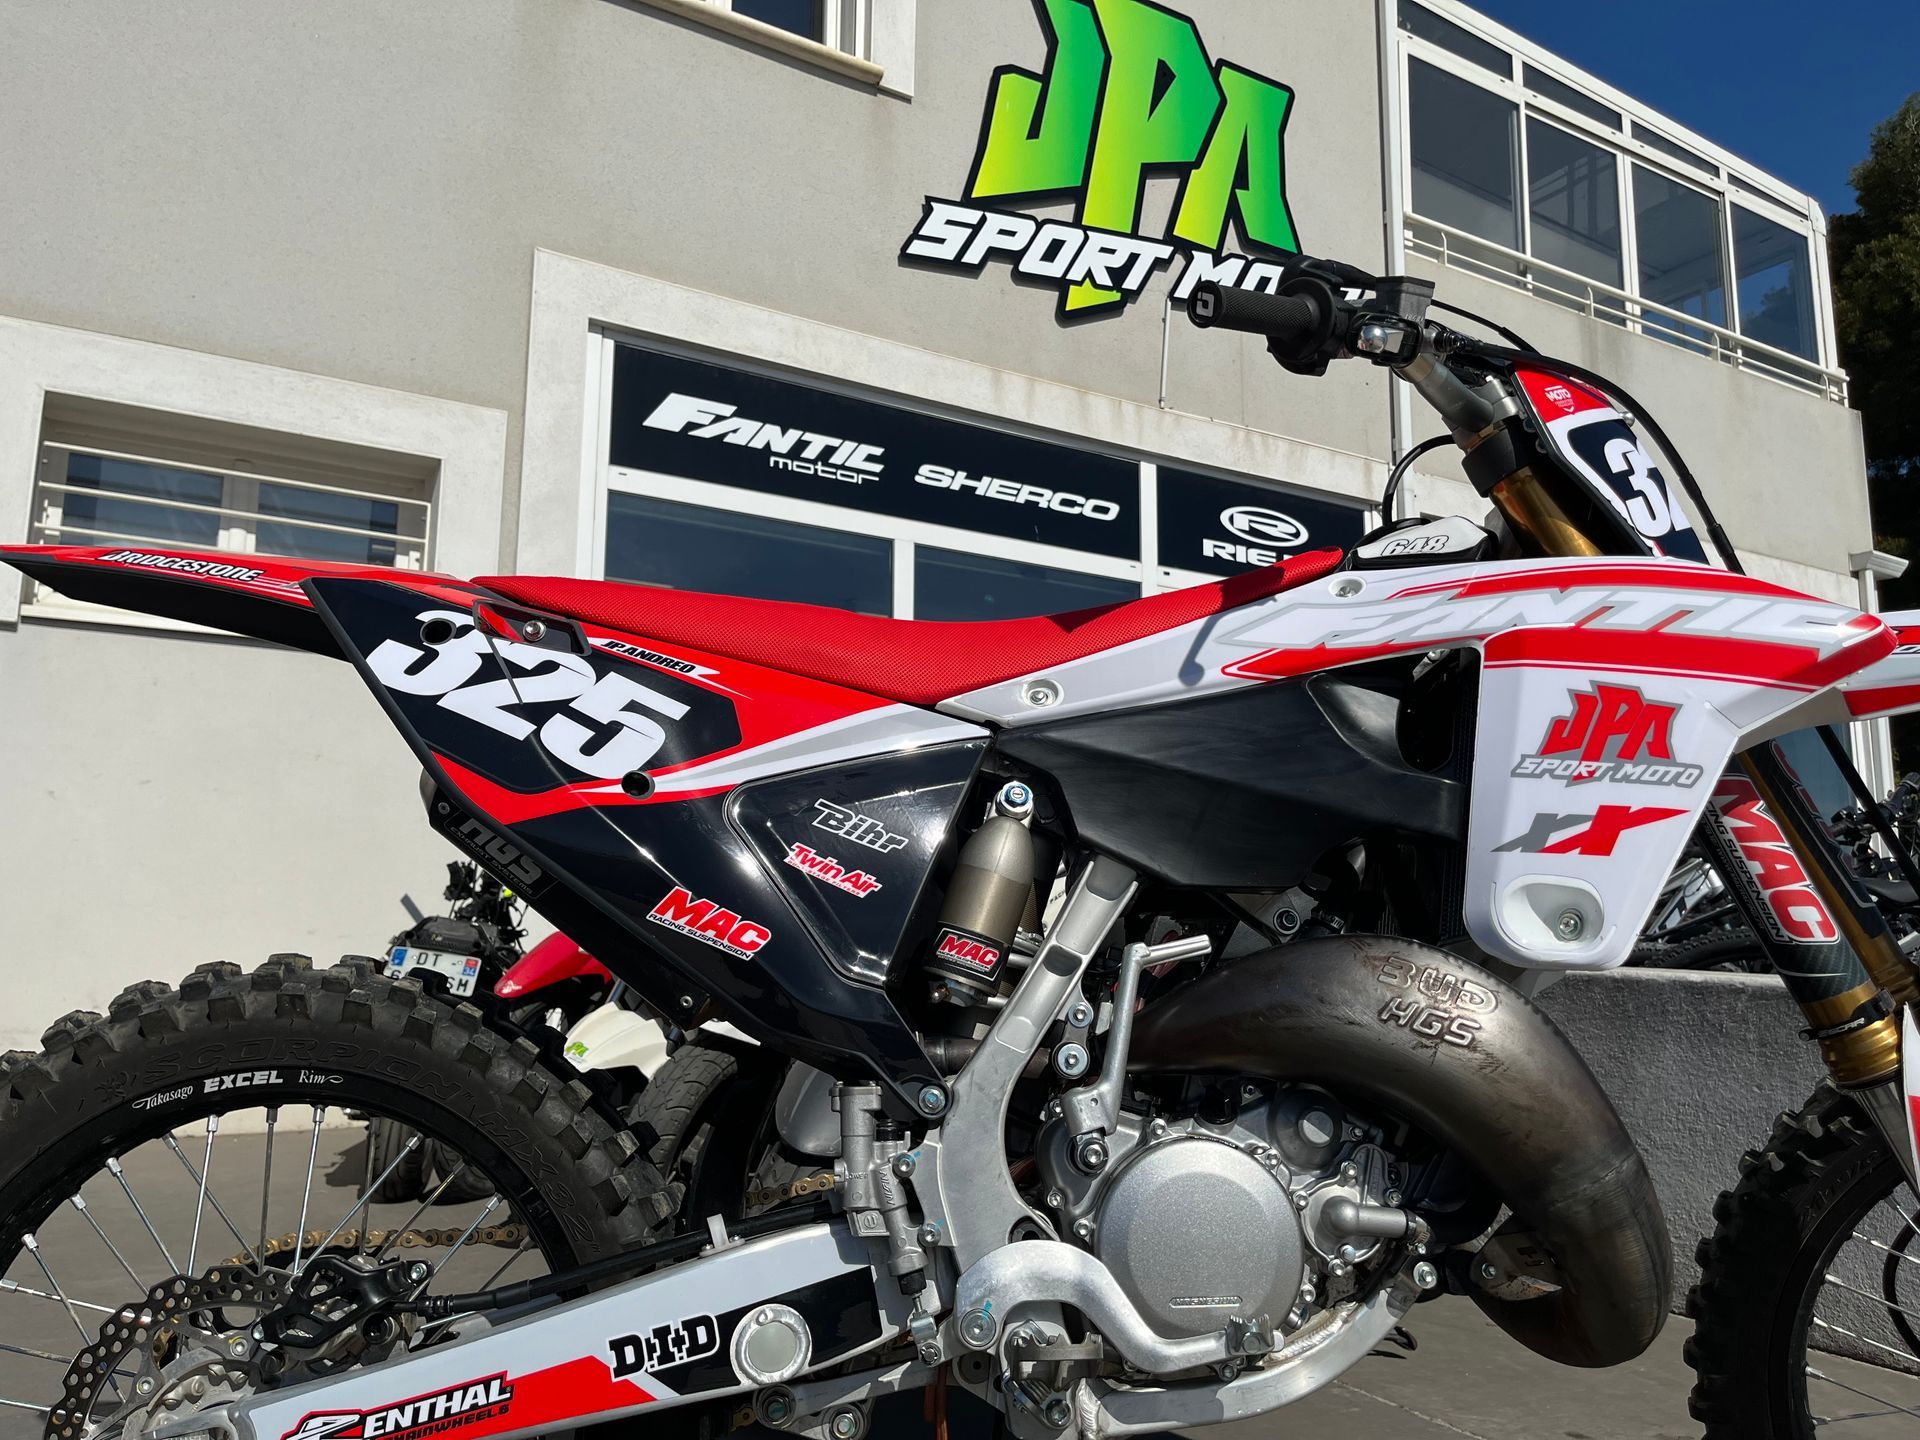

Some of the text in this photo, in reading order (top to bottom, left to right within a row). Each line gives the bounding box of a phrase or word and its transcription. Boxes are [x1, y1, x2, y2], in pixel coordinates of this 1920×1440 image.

[971, 0, 1298, 255] JPA
[905, 201, 1174, 291] SPORT
[642, 392, 886, 473] FANTIC
[769, 455, 880, 485] motor
[914, 463, 1120, 522] SHERCO
[98, 550, 265, 581] BRIDGESTONE
[1380, 534, 1450, 557] 648
[1215, 587, 1885, 660] FANTIC
[365, 609, 692, 780] 325
[1538, 684, 1677, 764] JPA
[1515, 756, 1705, 786] SPORT MOTO
[811, 797, 910, 854] Bihr
[794, 843, 881, 894] Twin Air
[1712, 778, 1838, 940] MAC
[1724, 838, 1785, 938] SUSPENSION
[648, 912, 752, 960] RACING SUSPENSION
[653, 887, 771, 953] MAC
[940, 935, 1000, 967] MAC
[1379, 996, 1482, 1047] HGS
[132, 1068, 336, 1111] Takasago EXCEL Rim
[143, 1036, 462, 1101] SCORPION
